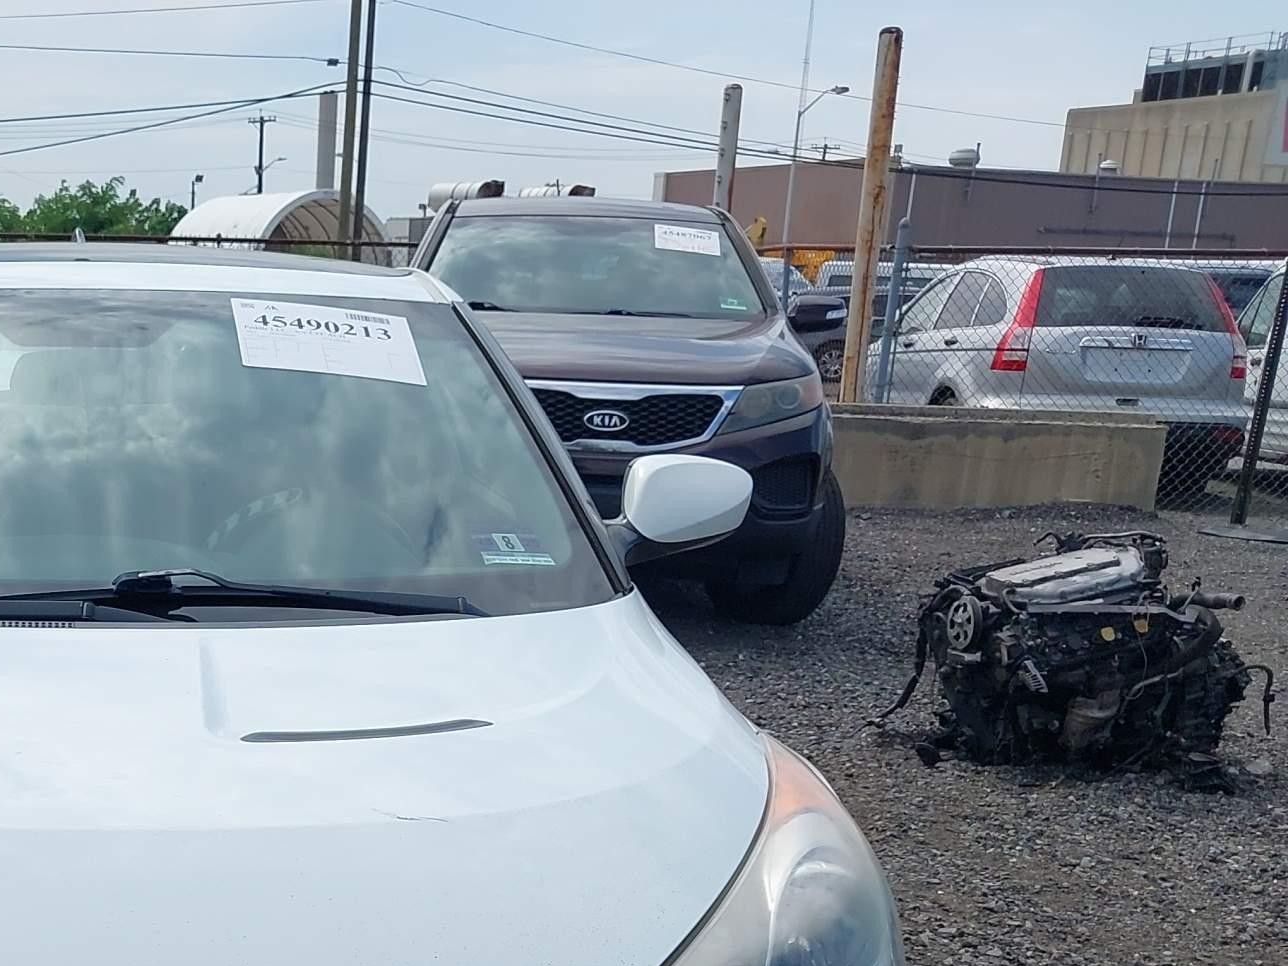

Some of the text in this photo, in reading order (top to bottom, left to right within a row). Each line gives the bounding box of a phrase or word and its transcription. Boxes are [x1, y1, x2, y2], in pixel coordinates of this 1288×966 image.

[254, 314, 392, 341] 45490213
[593, 415, 620, 426] KIA
[501, 535, 515, 550] 8
